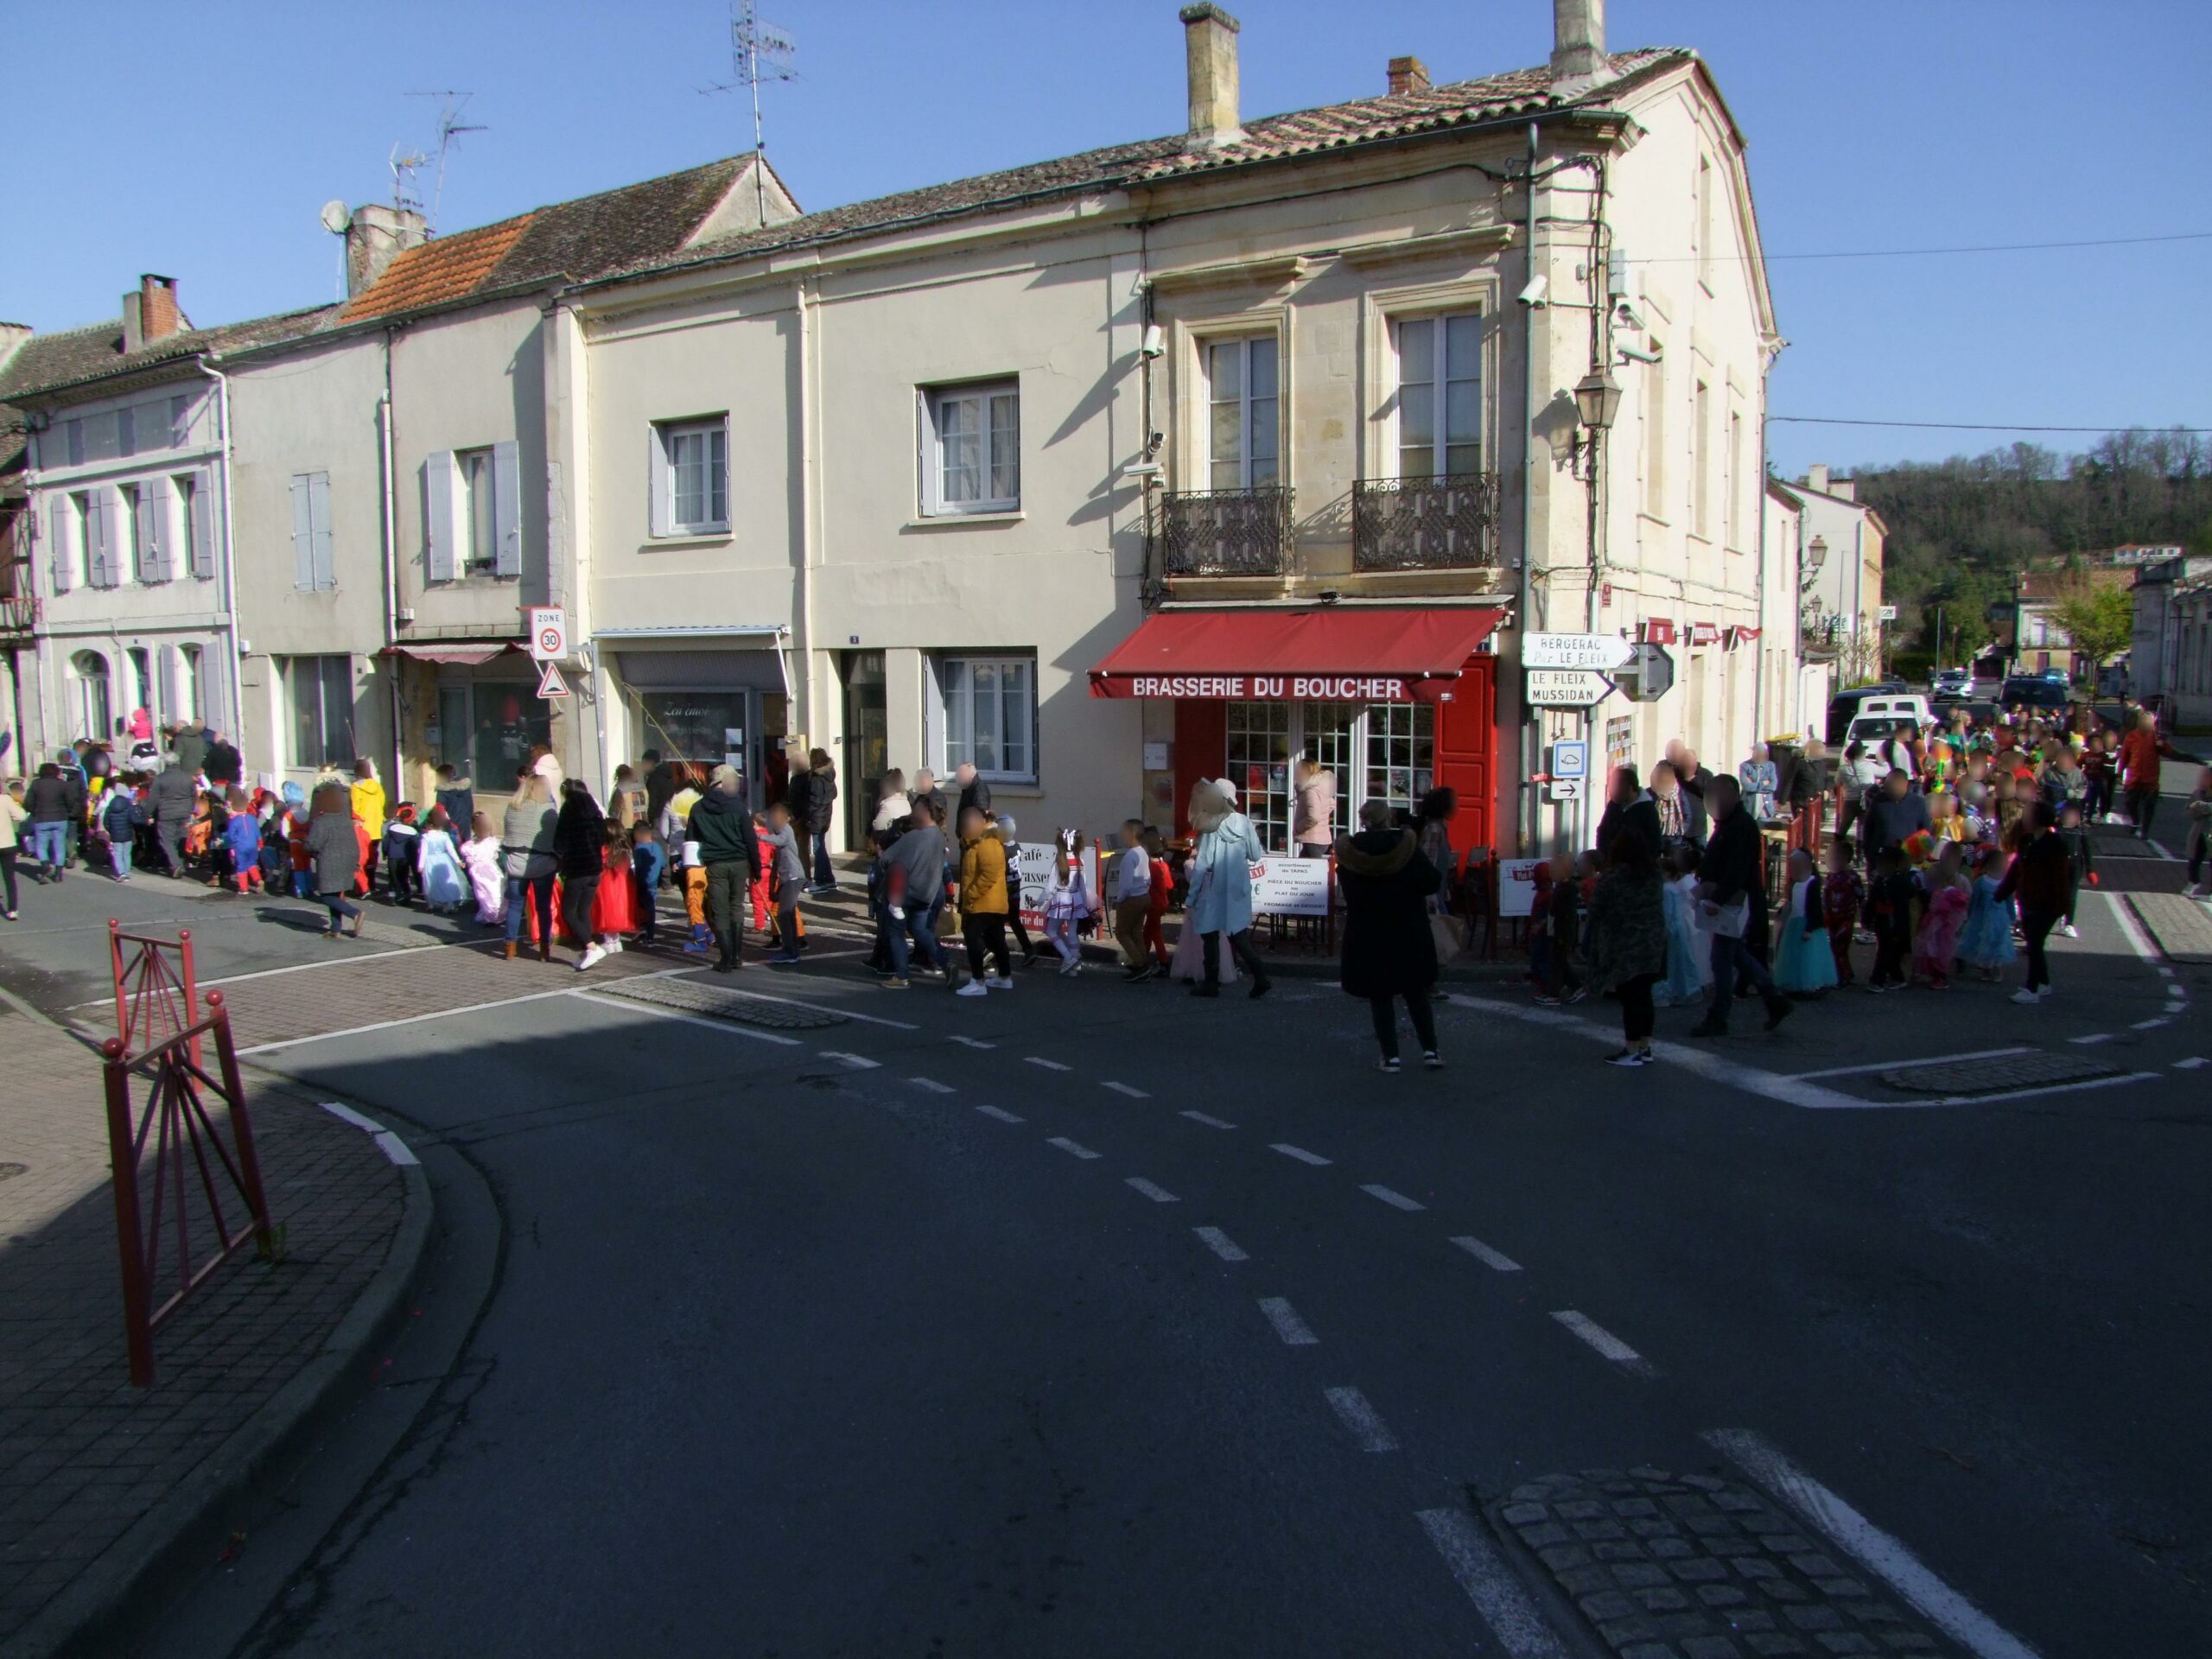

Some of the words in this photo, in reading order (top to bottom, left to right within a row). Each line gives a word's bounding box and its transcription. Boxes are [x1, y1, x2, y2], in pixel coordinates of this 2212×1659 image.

[544, 635, 557, 645] 30
[1541, 638, 1601, 650] BERGERAC
[1560, 652, 1572, 664] LE
[1579, 652, 1608, 664] FLEIX
[1532, 673, 1546, 684] LE
[1554, 673, 1586, 684] FLEIX
[1133, 677, 1244, 696] BRASSERIE
[1254, 677, 1284, 696] DU
[1294, 677, 1402, 698] BOUCHER
[1532, 690, 1593, 701] MUSSIDAN
